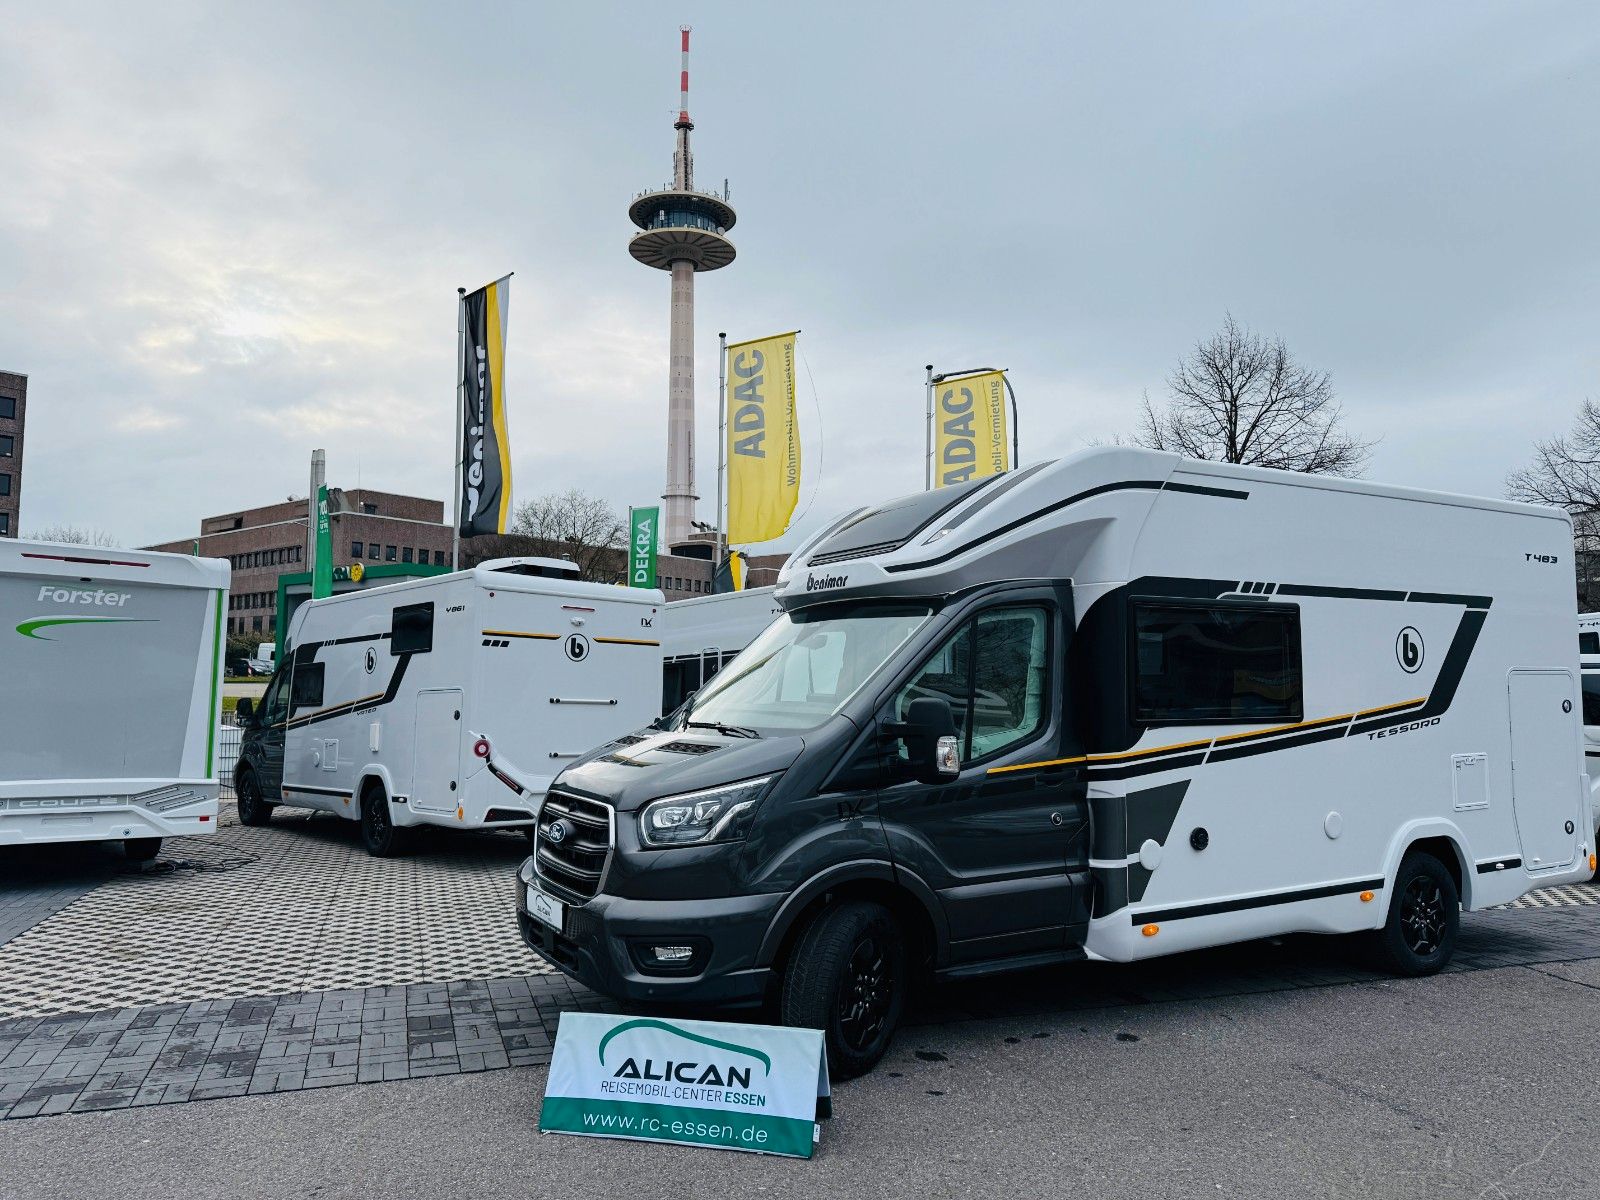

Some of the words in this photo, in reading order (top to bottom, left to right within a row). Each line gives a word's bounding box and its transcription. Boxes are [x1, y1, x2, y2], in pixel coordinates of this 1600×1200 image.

[734, 350, 765, 458] ADAC
[942, 387, 976, 485] ADAC
[990, 380, 1002, 473] obil-Vermietung
[635, 518, 651, 583] DEKRA
[37, 585, 131, 607] Forster
[806, 572, 849, 592] benimar
[1368, 718, 1441, 740] TESSORO
[613, 1057, 751, 1089] ALICAN
[600, 1080, 722, 1103] REISEMOBIL-CENTER
[724, 1091, 766, 1107] ESSEN
[582, 1111, 768, 1143] www.rc-essen.de
